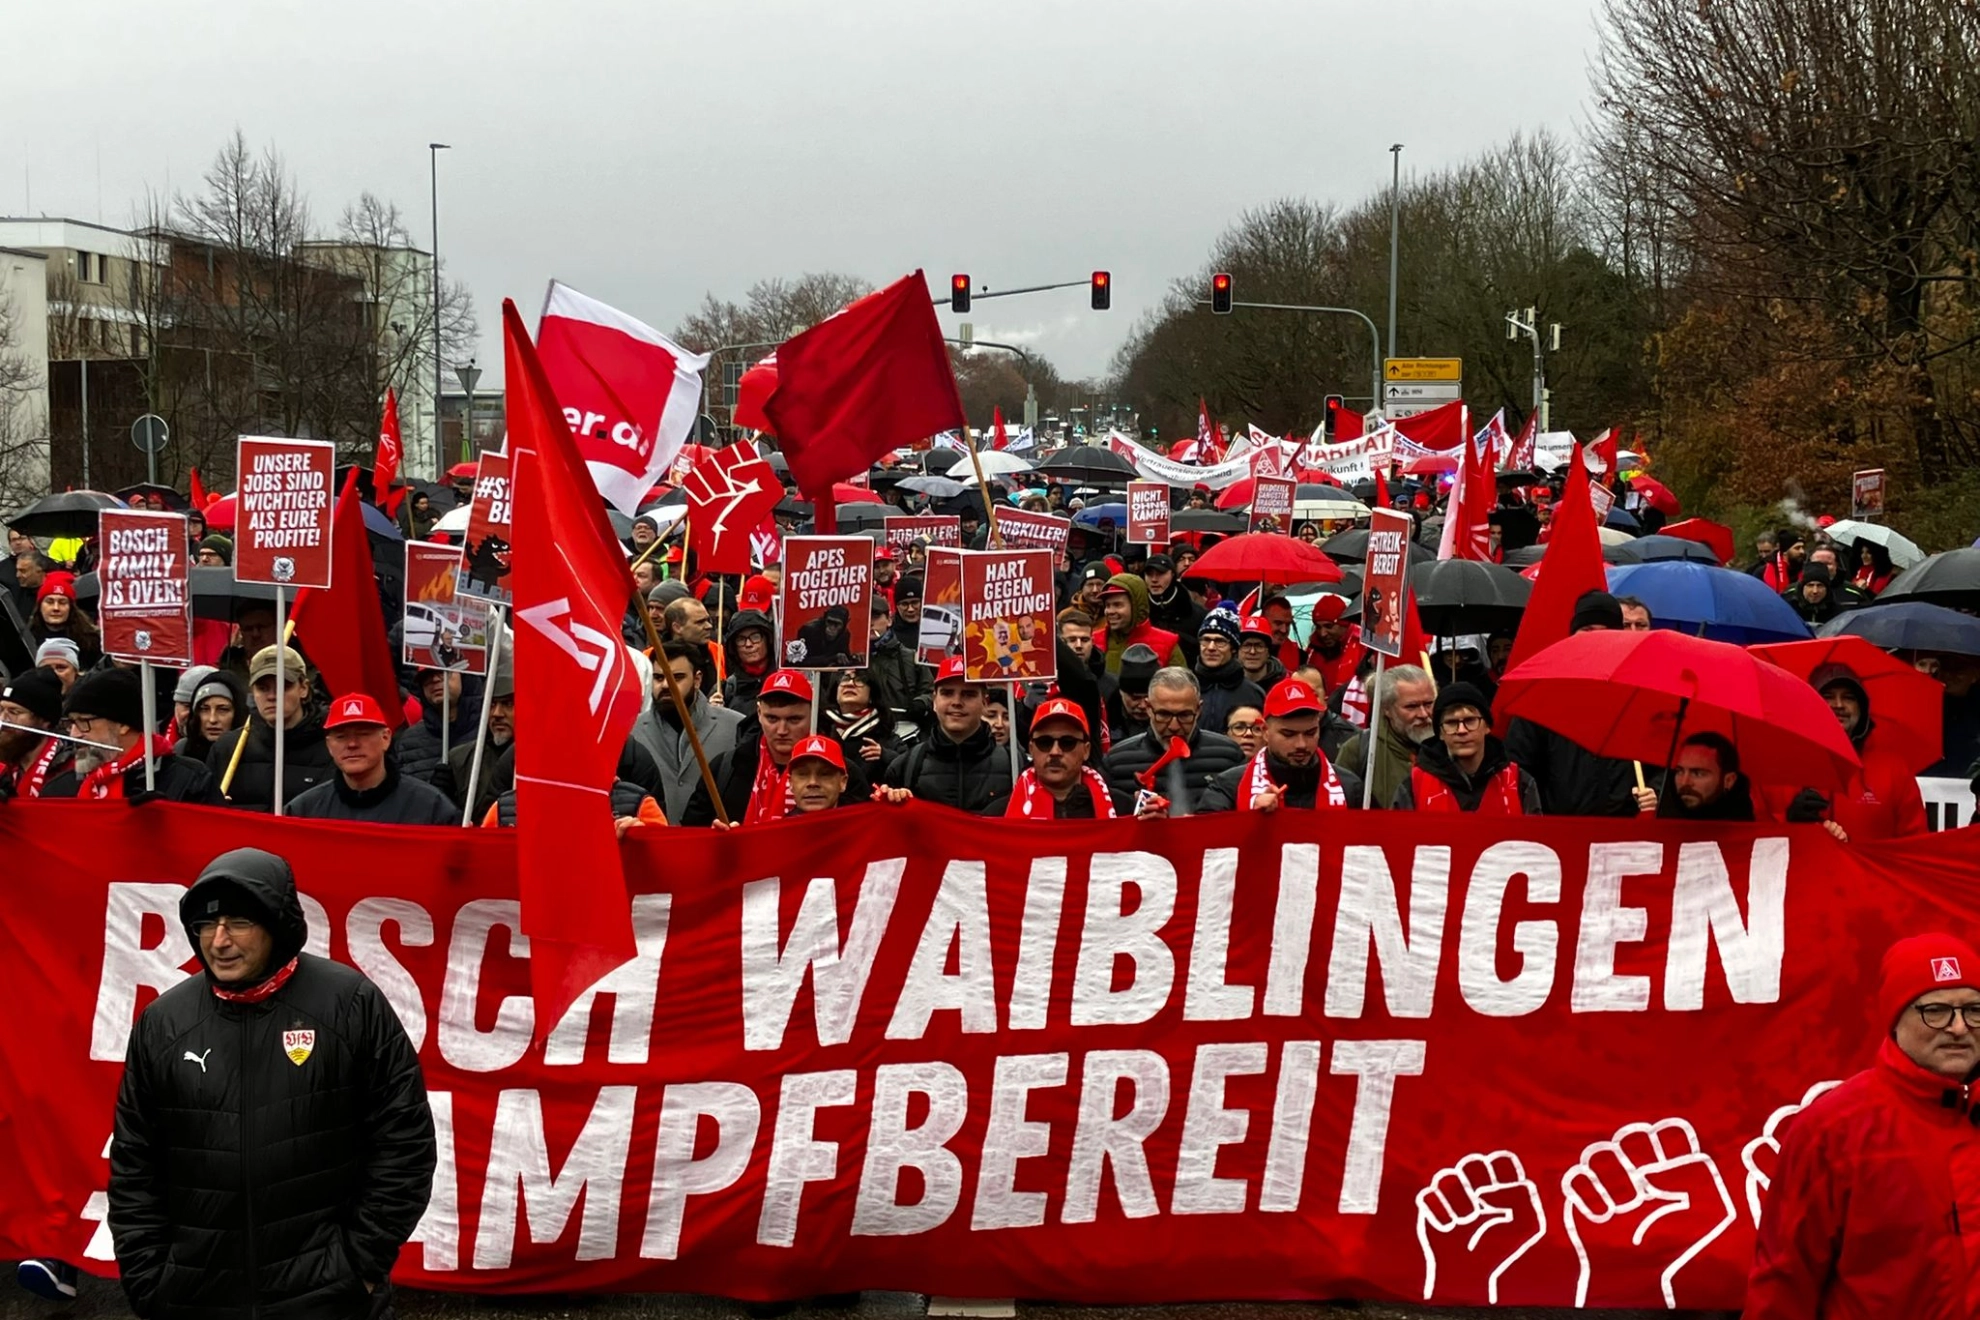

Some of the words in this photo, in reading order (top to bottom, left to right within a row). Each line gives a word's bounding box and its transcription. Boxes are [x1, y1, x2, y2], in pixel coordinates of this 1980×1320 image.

[253, 453, 312, 473] UNSERE
[243, 473, 282, 493] JOBS
[285, 472, 324, 491] SIND
[243, 490, 327, 511] WICHTIGER
[1131, 501, 1168, 510] OHNE
[1132, 490, 1163, 503] NICHT
[248, 512, 276, 530] ALS
[279, 510, 319, 529] EURE
[1132, 509, 1169, 522] KAMPF!
[109, 528, 168, 554] BOSCH
[253, 528, 321, 549] PROFITE!
[107, 553, 176, 579] FAMILY
[805, 548, 845, 570] APES
[1372, 553, 1400, 575] BEREIT
[790, 565, 868, 591] TOGETHER
[985, 559, 1027, 582] HART
[105, 580, 124, 605] IS
[128, 579, 183, 605] OVER!
[798, 585, 861, 610] STRONG
[983, 577, 1033, 601] GEGEN
[971, 593, 1051, 621] HARTUNG!
[90, 882, 672, 1072] BSCH
[741, 837, 1790, 1051] WAIBLINGEN
